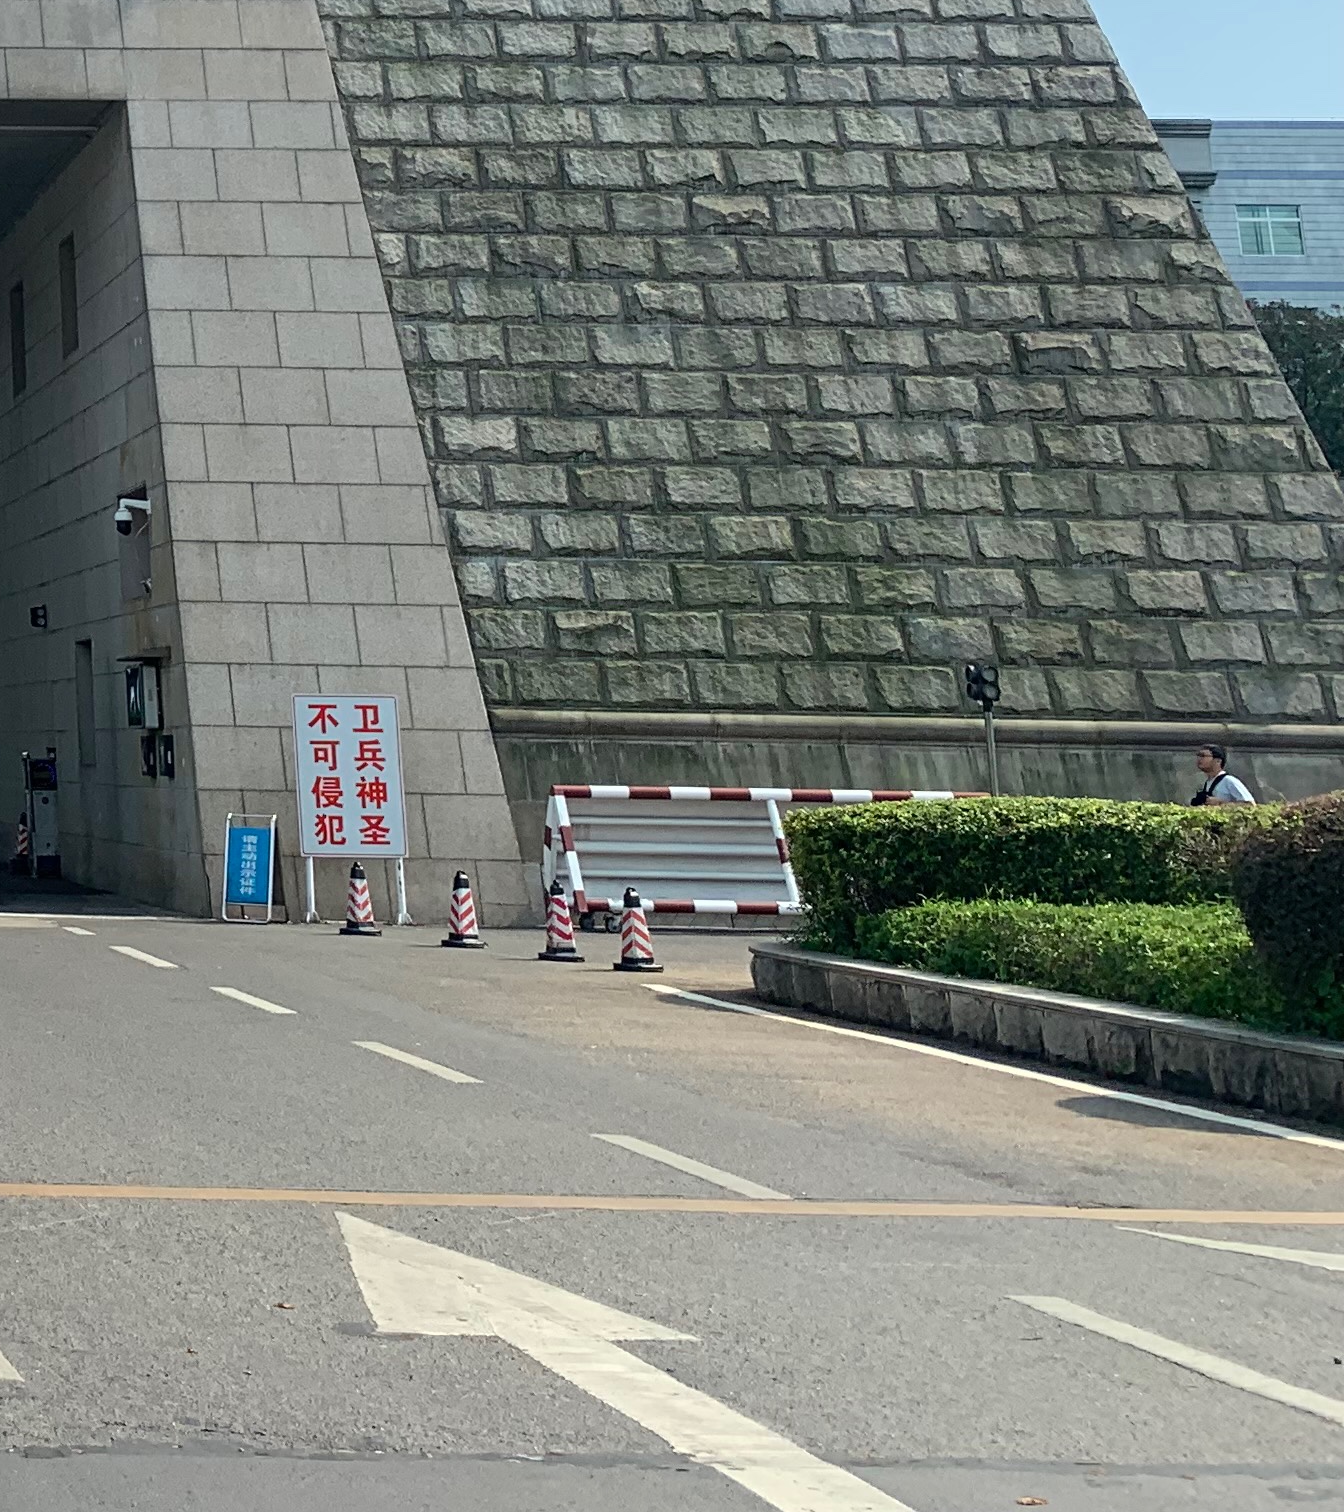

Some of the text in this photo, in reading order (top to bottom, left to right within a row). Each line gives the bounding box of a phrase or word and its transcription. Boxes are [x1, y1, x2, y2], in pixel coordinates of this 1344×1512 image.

[307, 704, 347, 846] 不可侵犯
[352, 704, 391, 845] 卫兵神圣
